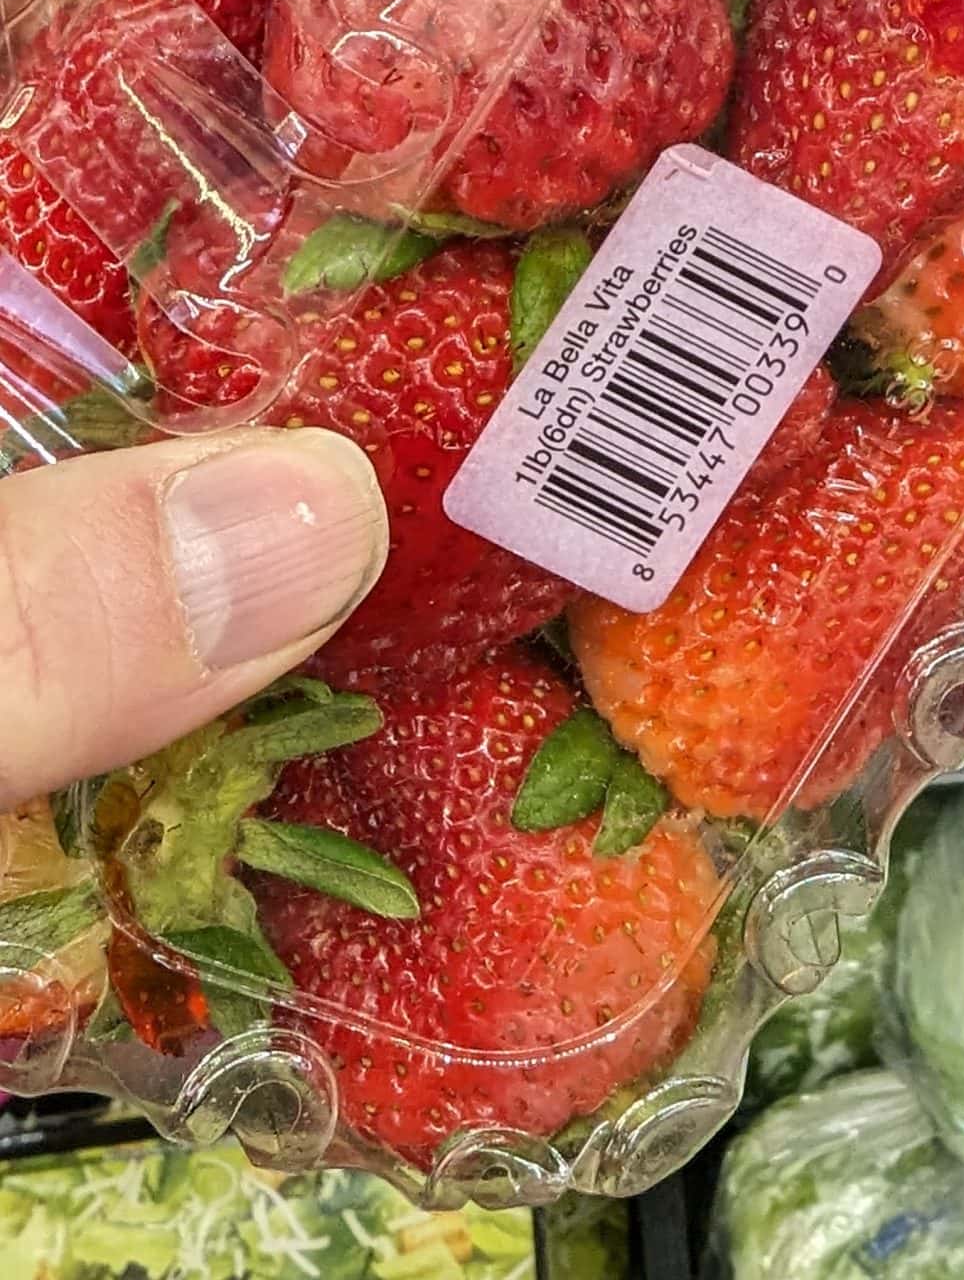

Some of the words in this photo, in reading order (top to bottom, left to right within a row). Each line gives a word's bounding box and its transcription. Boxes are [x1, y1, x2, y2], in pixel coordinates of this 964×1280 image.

[515, 387, 597, 486] 1lb(6dn)
[581, 224, 697, 383] Strawberries
[518, 387, 556, 420] La
[542, 320, 600, 383] Bella
[585, 265, 634, 311] Vita
[632, 564, 655, 581] 8
[659, 426, 735, 532] 53447
[733, 313, 809, 416] 00339
[824, 265, 847, 285] 0
